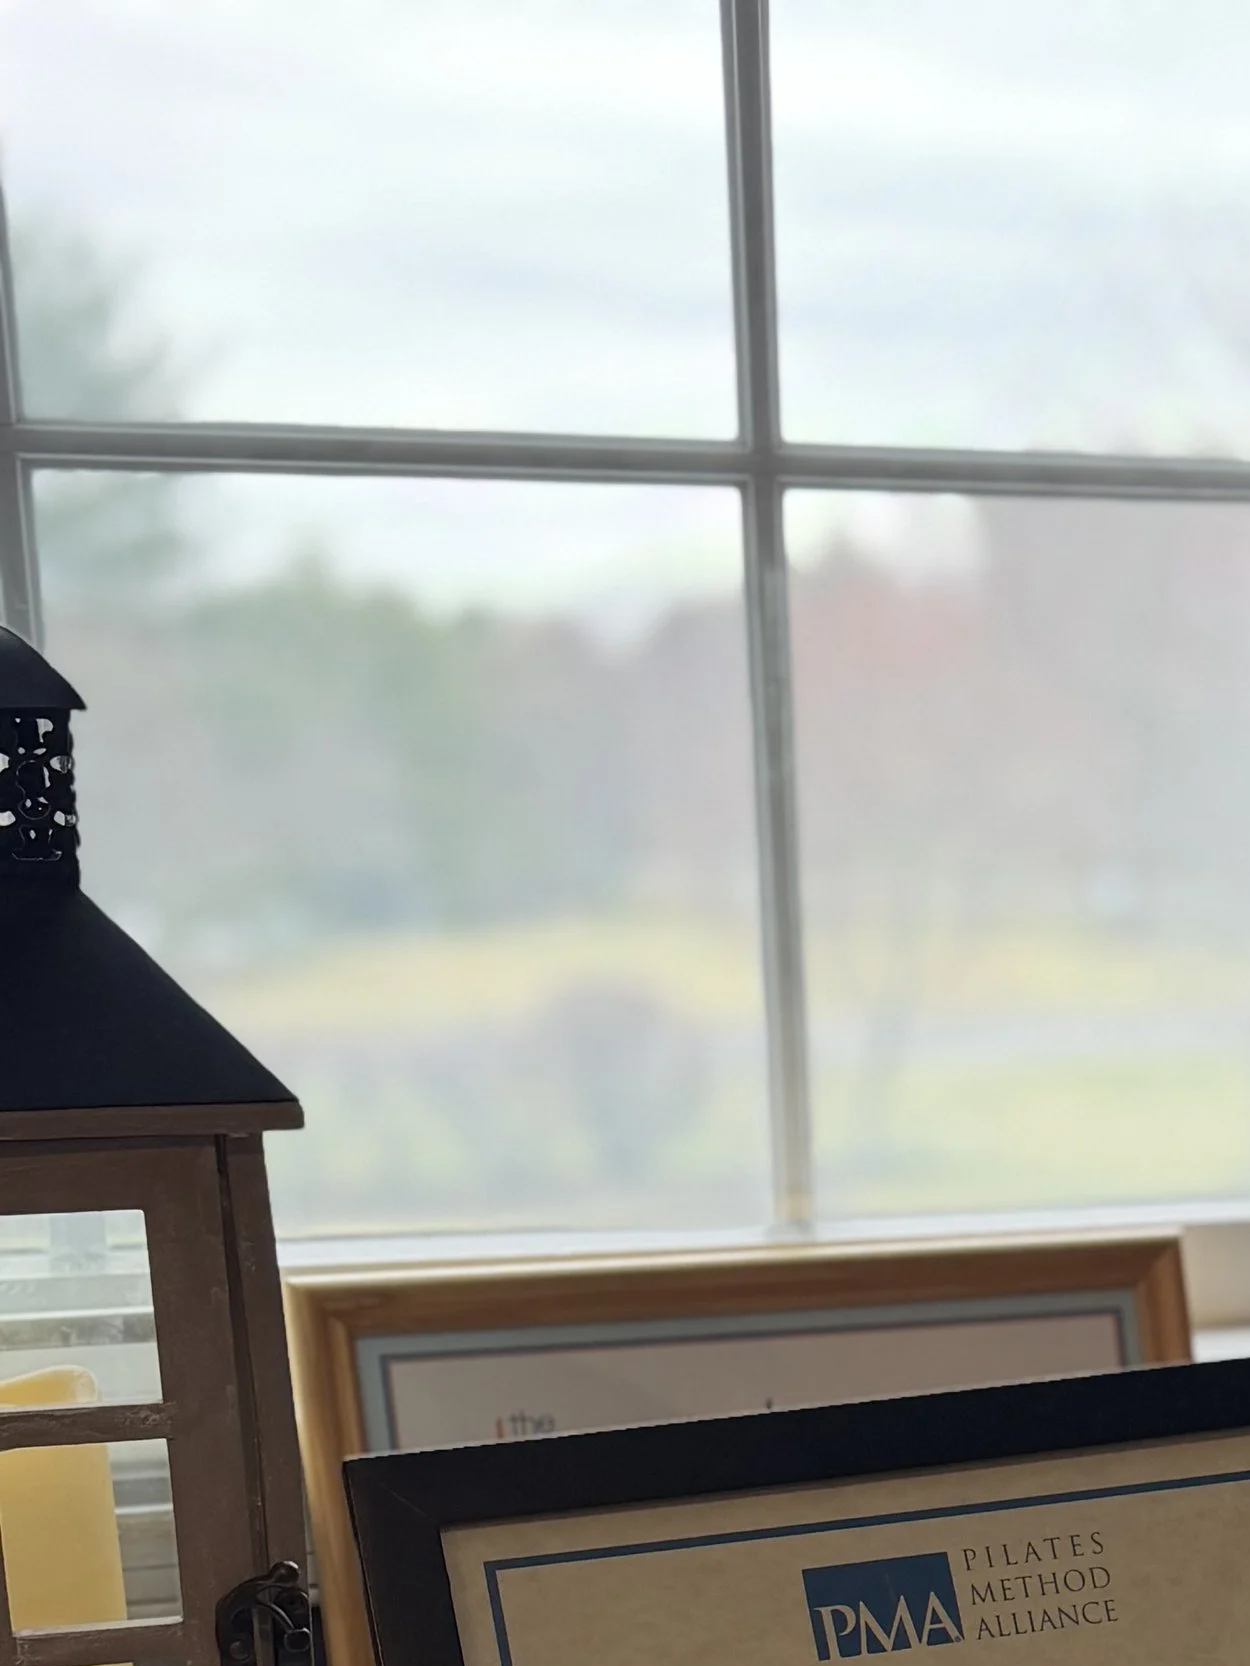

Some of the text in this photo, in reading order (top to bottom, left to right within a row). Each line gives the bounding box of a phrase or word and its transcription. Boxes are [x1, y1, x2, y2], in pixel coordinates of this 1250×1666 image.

[962, 1532, 1104, 1571] PILATES
[970, 1566, 1111, 1605] METHOD
[976, 1599, 1118, 1640] ALLIANCE
